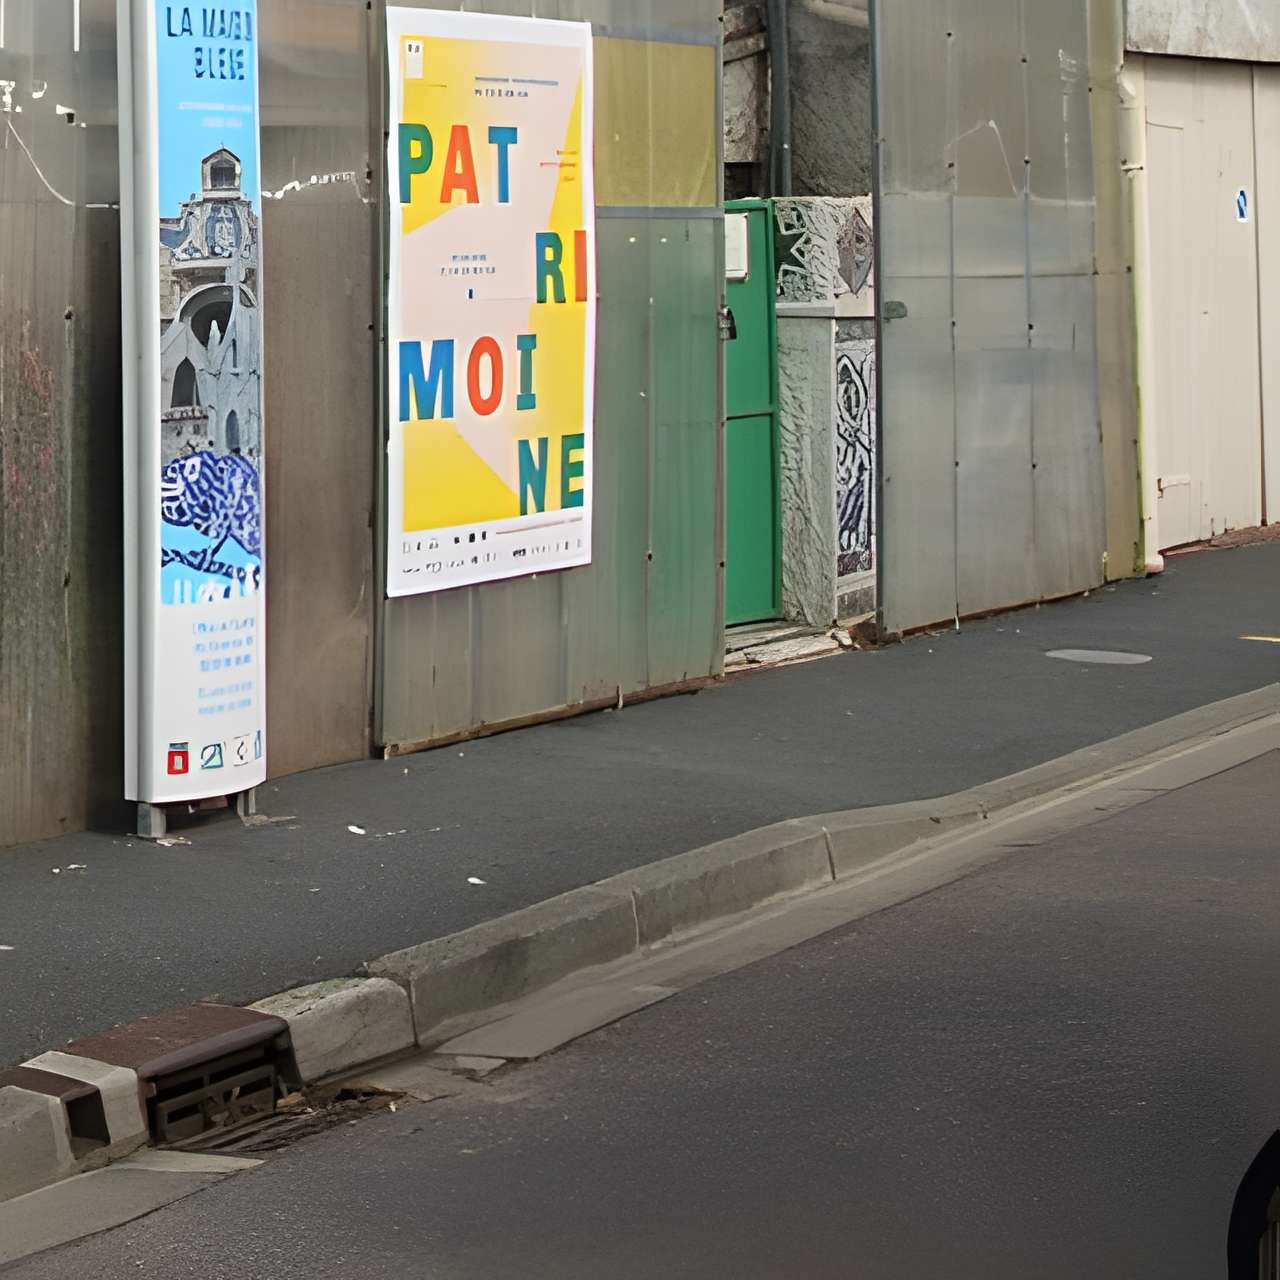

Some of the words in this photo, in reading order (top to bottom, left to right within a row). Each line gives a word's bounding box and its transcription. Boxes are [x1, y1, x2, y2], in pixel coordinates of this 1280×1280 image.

[166, 7, 193, 37] LA
[398, 123, 518, 204] PAT
[535, 230, 588, 304] RI
[398, 334, 537, 422] MOI
[517, 433, 585, 516] NE
